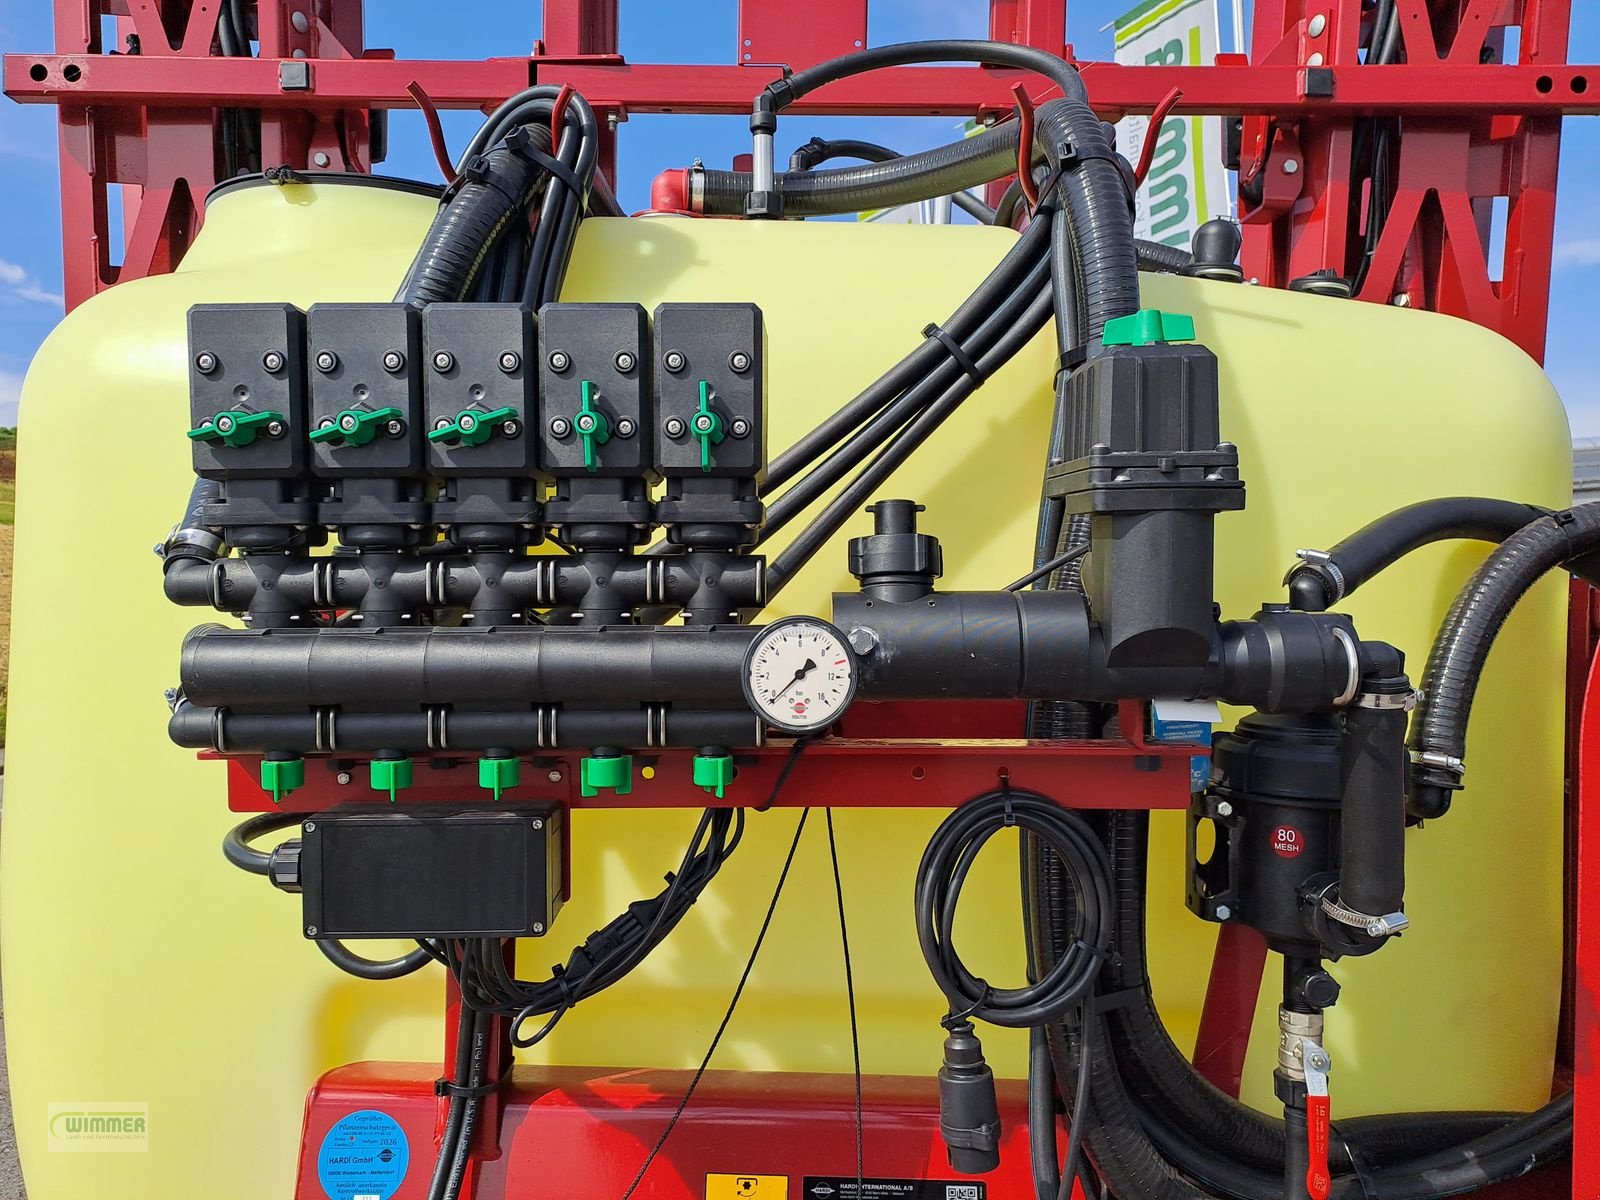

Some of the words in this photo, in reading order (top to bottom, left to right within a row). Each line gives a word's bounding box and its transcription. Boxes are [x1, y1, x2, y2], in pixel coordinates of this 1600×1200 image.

[775, 648, 780, 656] 4
[765, 672, 769, 680] 2
[818, 692, 825, 700] 16
[1277, 829, 1296, 842] 80
[1274, 842, 1299, 852] MESH
[474, 1033, 483, 1059] Poland
[473, 1062, 480, 1071] in
[380, 1138, 397, 1146] 2026
